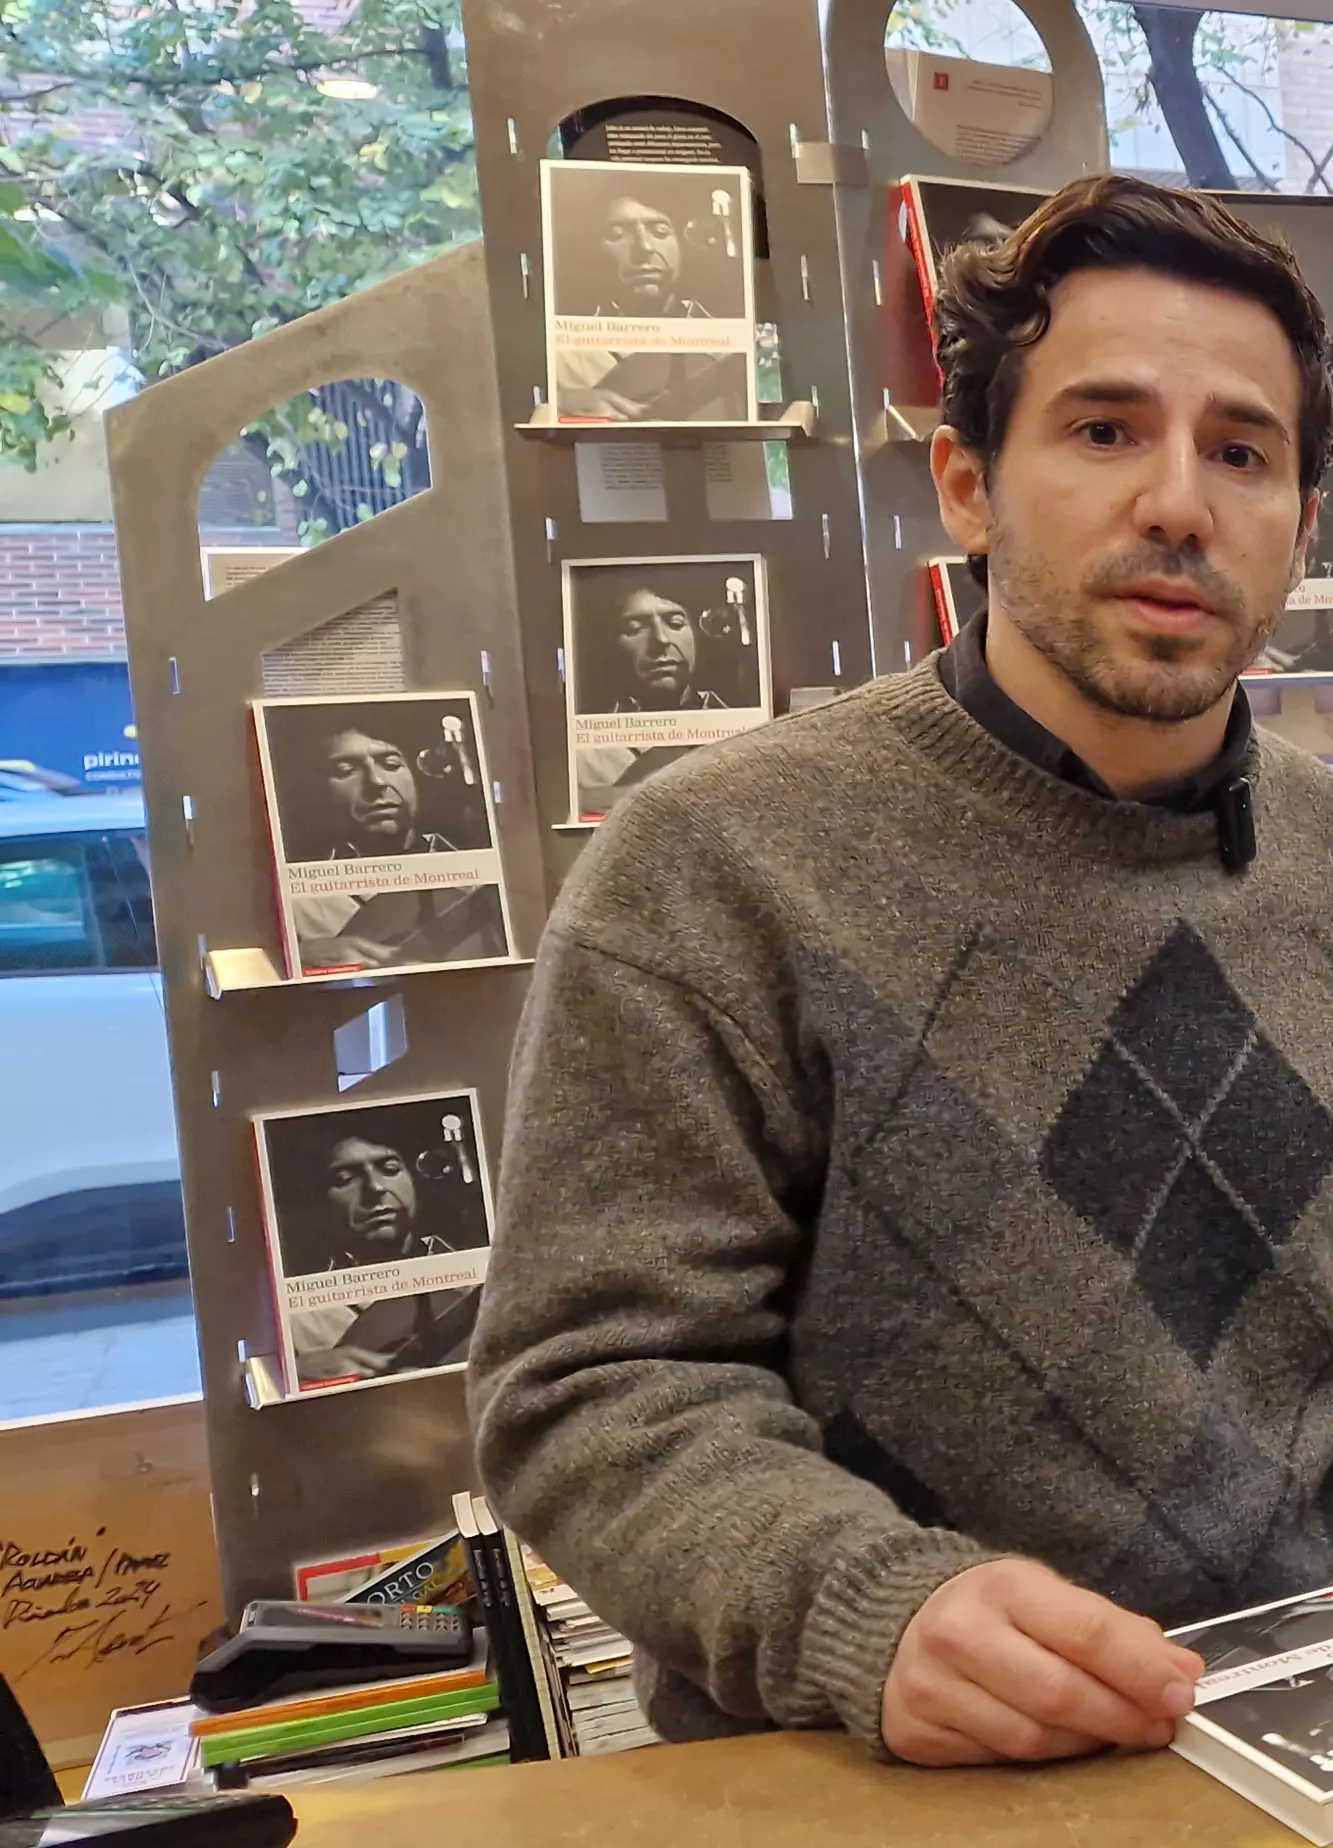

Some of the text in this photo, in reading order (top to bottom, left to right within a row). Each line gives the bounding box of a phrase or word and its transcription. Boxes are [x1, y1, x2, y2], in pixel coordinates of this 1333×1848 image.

[556, 320, 660, 333] Miguel Barrero
[555, 333, 731, 348] El guitarrista de Montreal
[1301, 595, 1312, 605] de
[576, 717, 677, 733] Miguel Barrero
[576, 727, 746, 745] El guitarrista de Montr
[288, 862, 402, 880] Miguel Barrero
[290, 868, 480, 895] El guitarrista de Montreal
[286, 1268, 400, 1296] Miguel Barrero
[288, 1268, 478, 1309] El guitarrista de Montreal
[1305, 1641, 1333, 1657] de
[1199, 1650, 1303, 1690] Montreal
